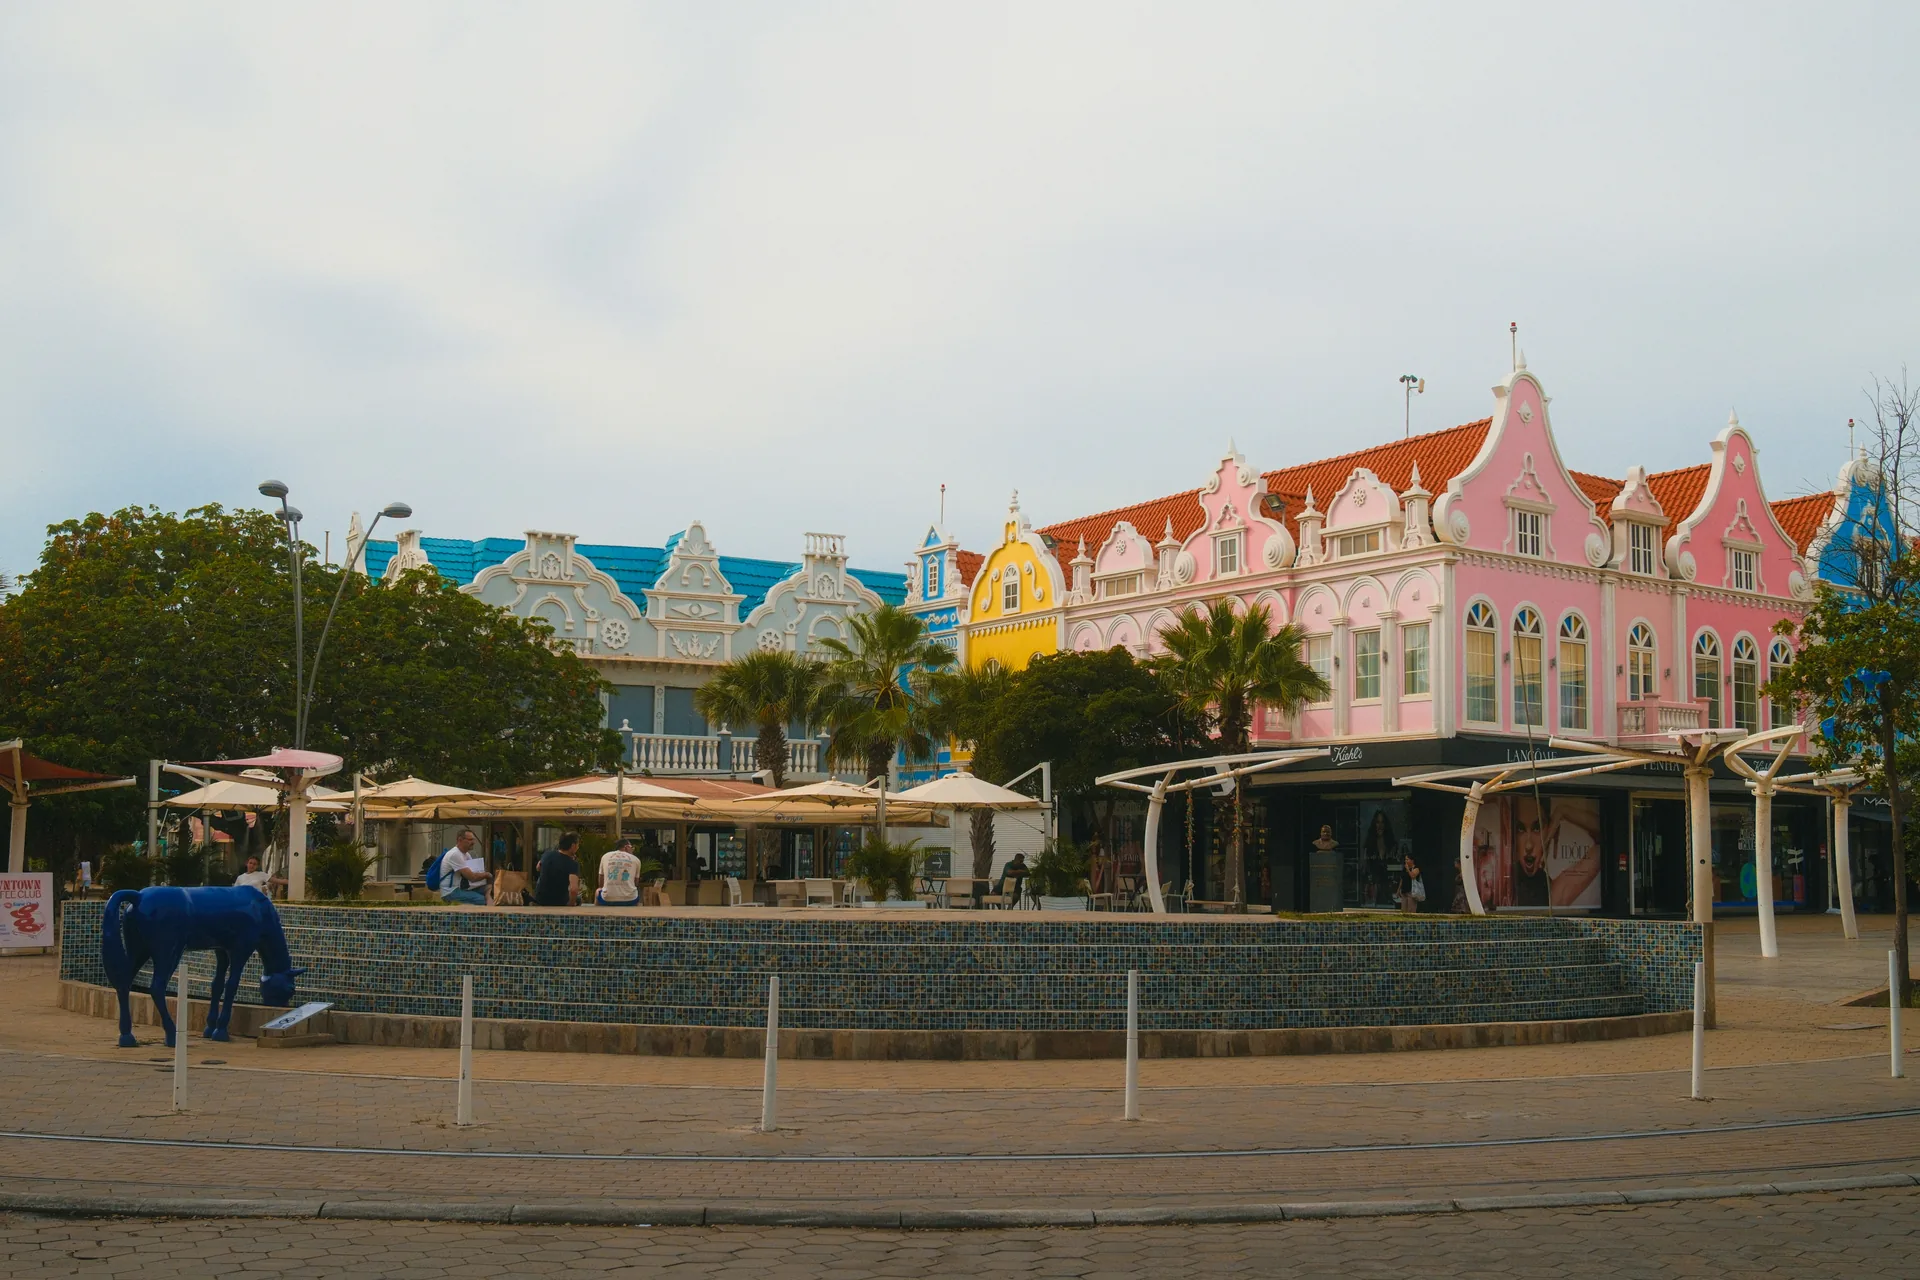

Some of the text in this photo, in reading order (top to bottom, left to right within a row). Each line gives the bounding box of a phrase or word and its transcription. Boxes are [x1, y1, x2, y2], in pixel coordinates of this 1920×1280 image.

[1332, 746, 1363, 763] Kiehl's
[0, 880, 41, 890] NTOWN
[18, 890, 41, 899] CLUB
